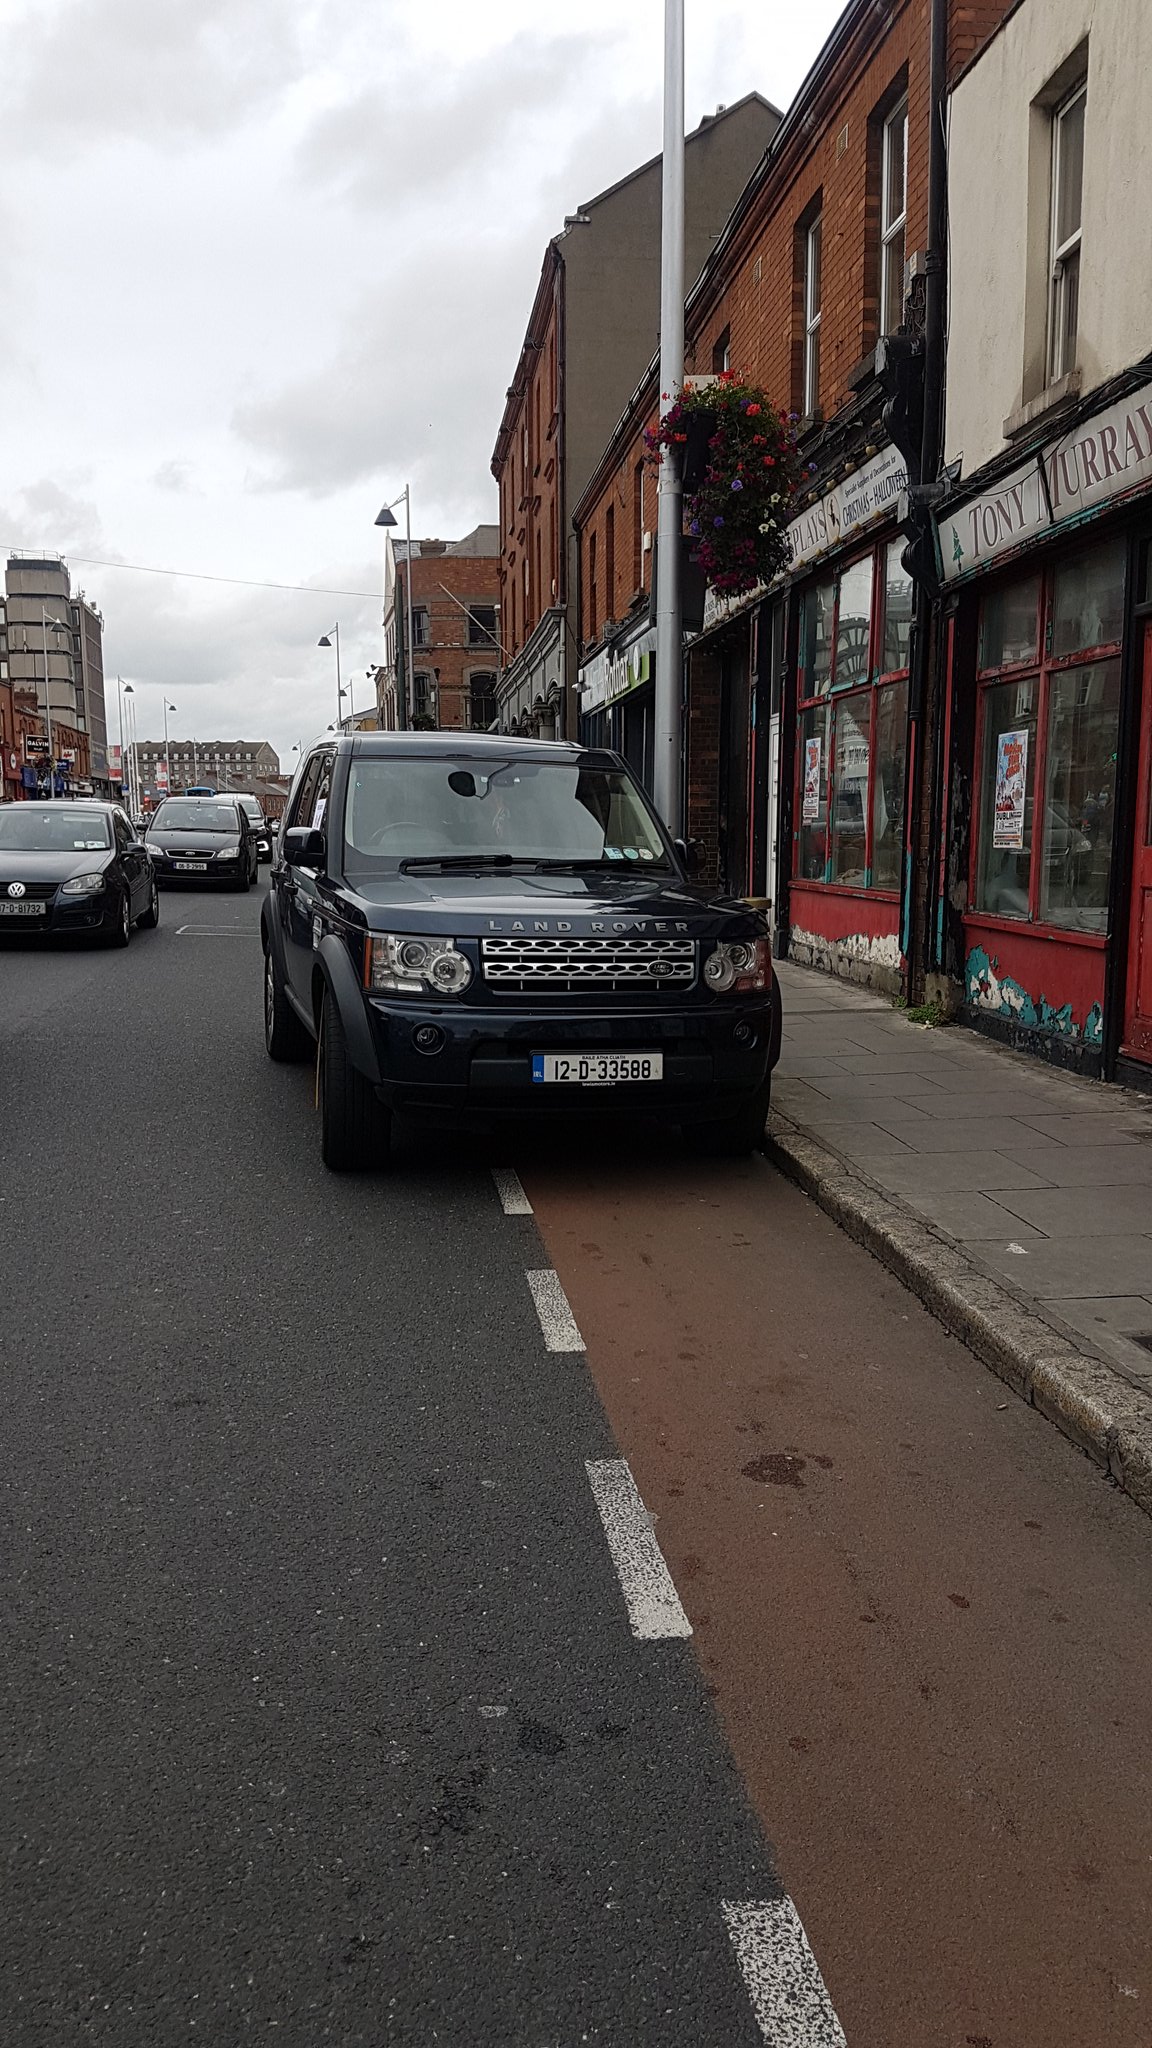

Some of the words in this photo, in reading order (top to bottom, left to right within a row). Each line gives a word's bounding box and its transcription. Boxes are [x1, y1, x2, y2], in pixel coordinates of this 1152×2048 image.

[842, 492, 871, 527] CHRISTMAS
[969, 481, 1029, 559] TONY
[791, 508, 828, 556] PLAYS
[0, 903, 41, 914] 7-D-81732
[489, 920, 572, 932] LAND
[591, 922, 689, 933] ROVER
[554, 1059, 651, 1080] 12-D-33588
